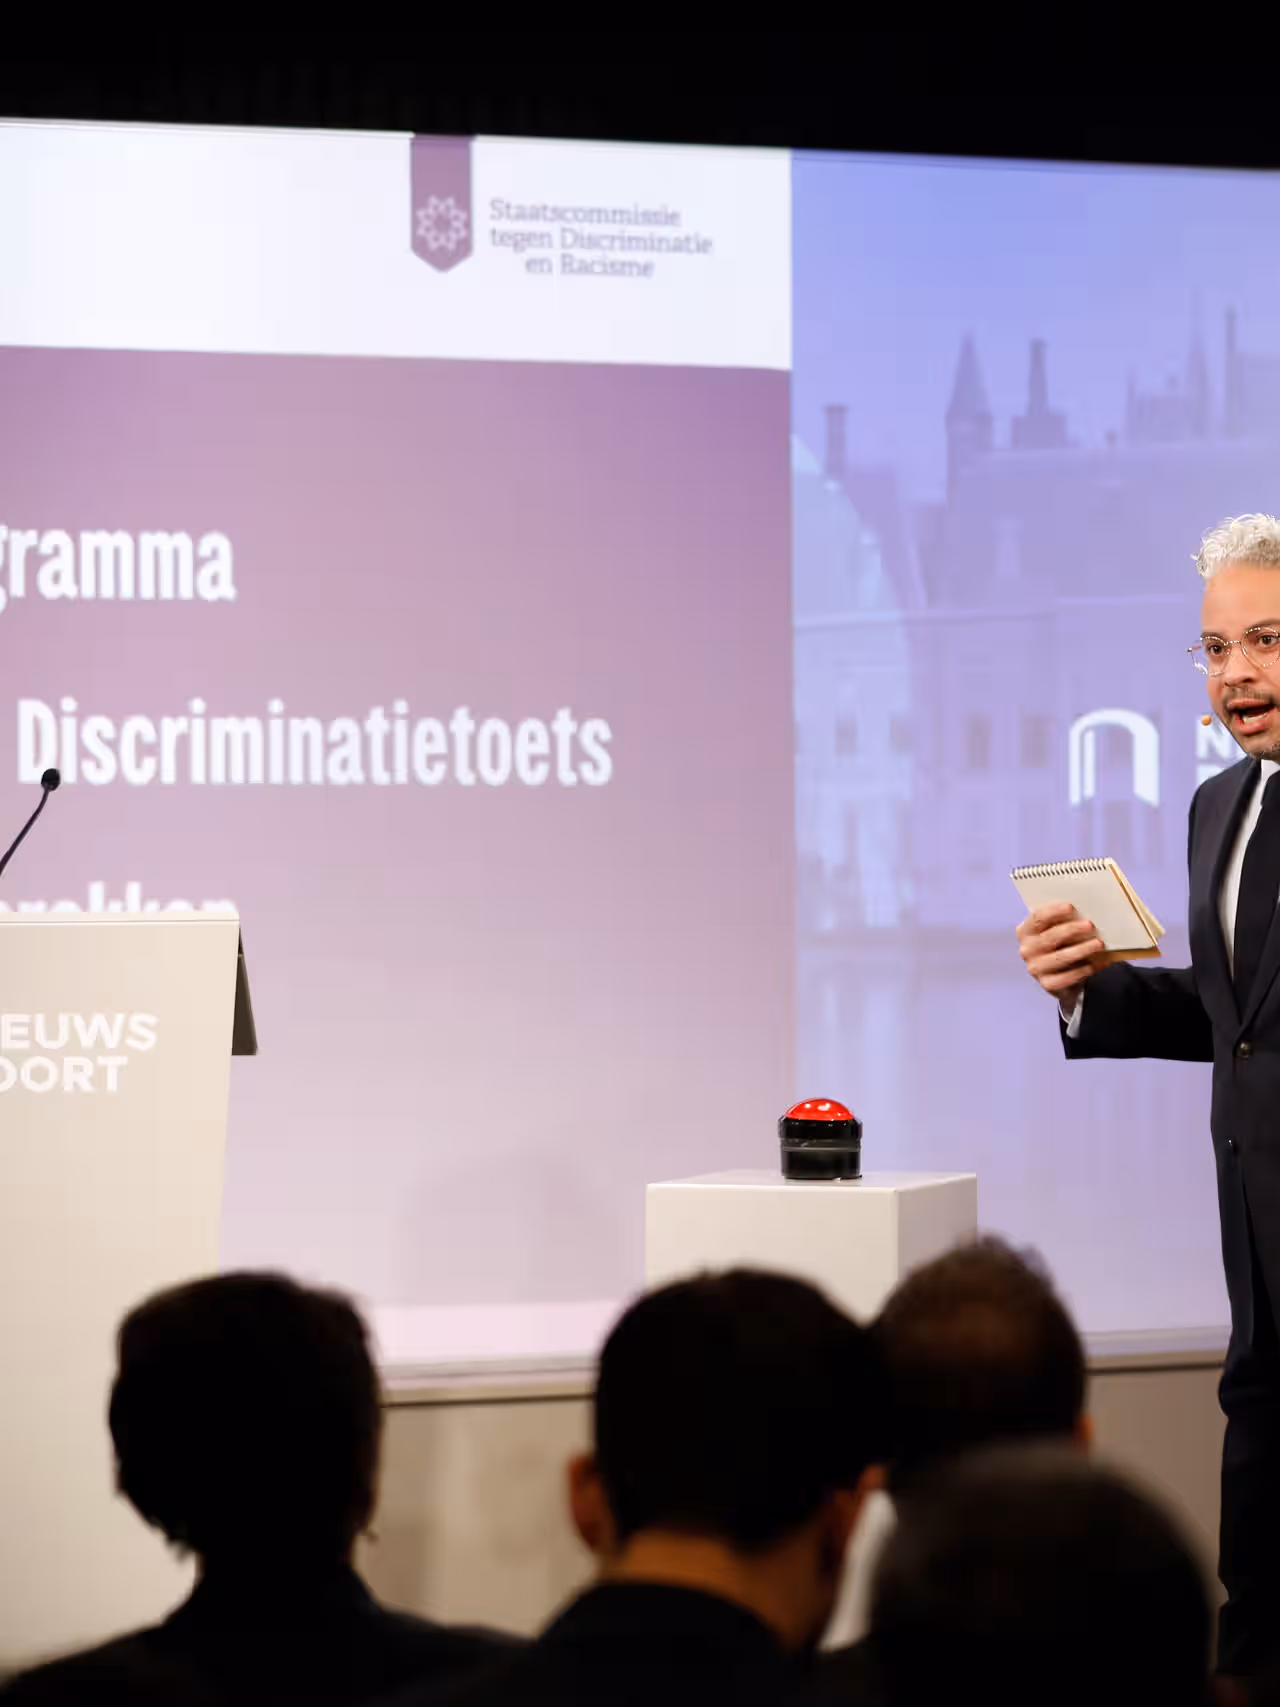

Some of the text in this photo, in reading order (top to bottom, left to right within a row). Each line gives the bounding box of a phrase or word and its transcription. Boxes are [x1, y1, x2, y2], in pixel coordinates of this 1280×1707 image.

[489, 198, 682, 228] Staatscommissie
[490, 227, 713, 254] tegen Discriminatie
[525, 254, 655, 278] en Racisme
[0, 523, 238, 614] ramma
[16, 696, 614, 787] Discriminatietoets
